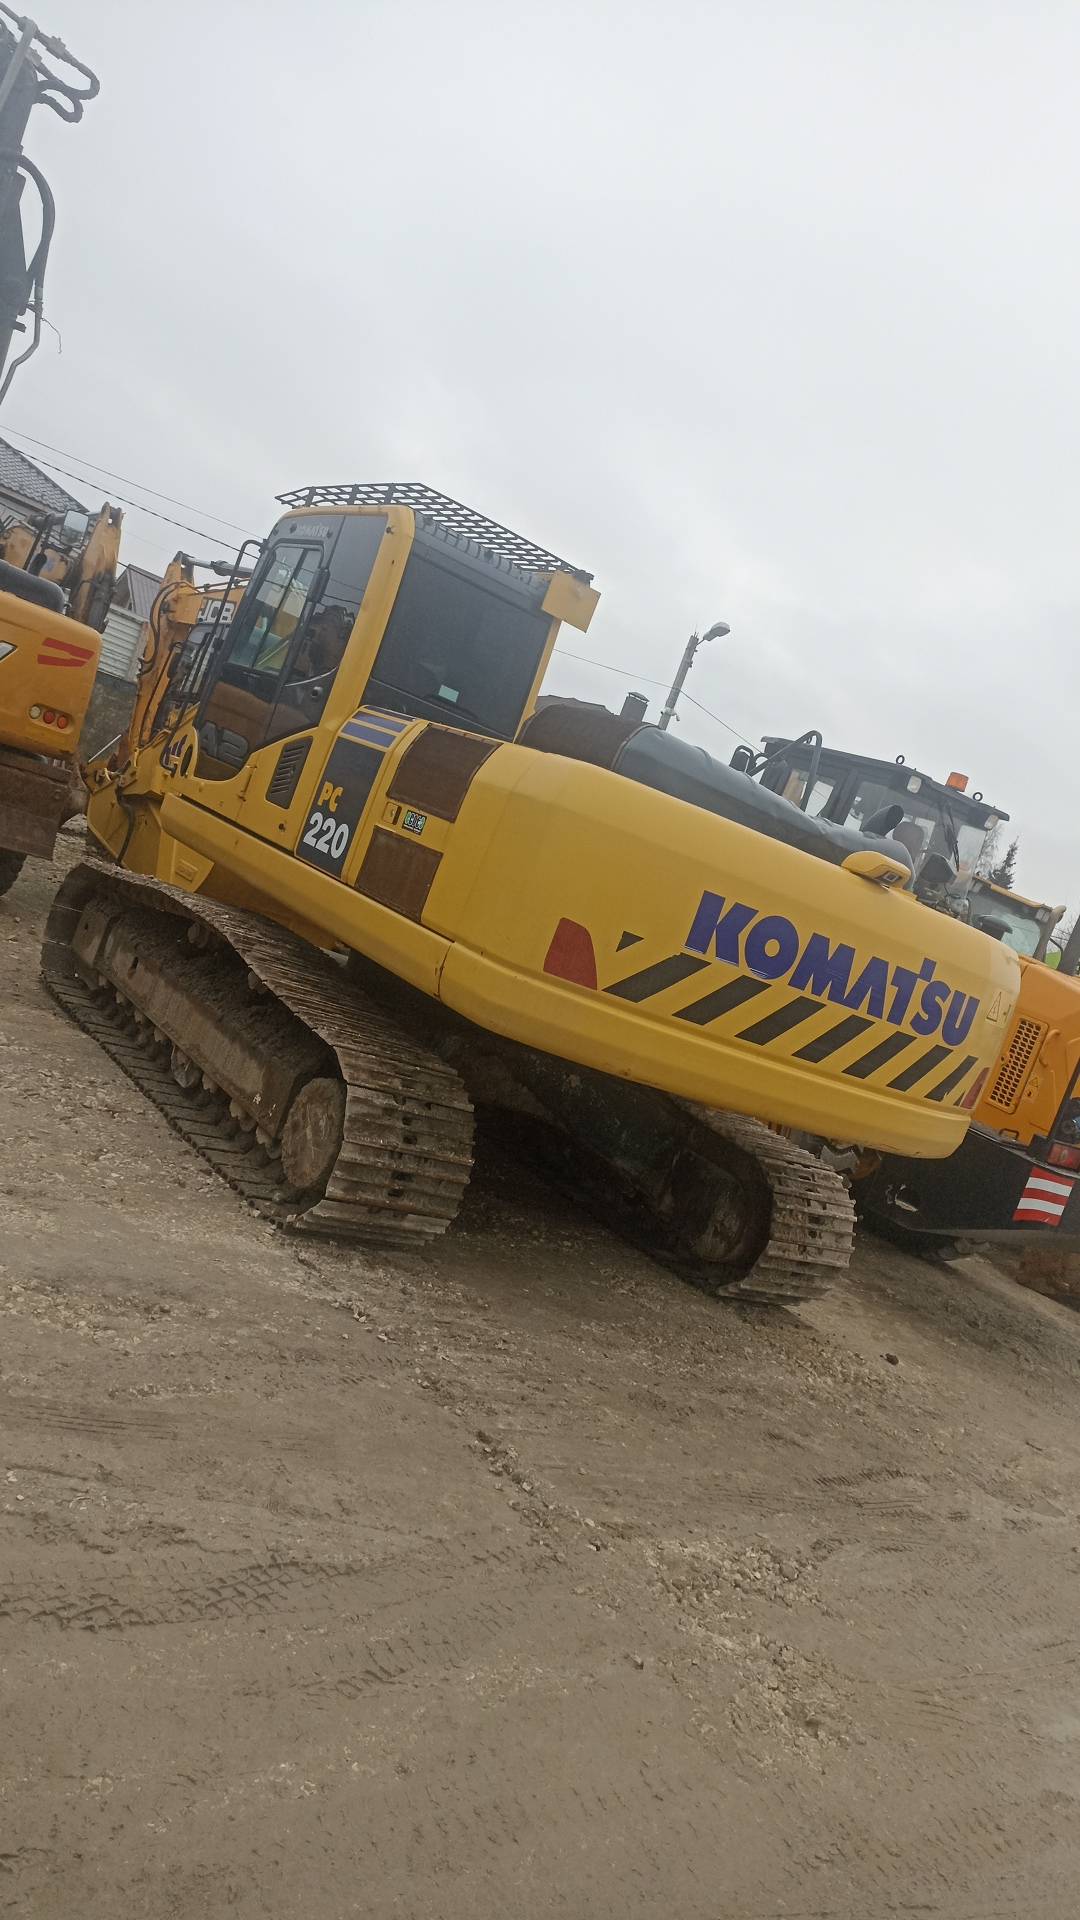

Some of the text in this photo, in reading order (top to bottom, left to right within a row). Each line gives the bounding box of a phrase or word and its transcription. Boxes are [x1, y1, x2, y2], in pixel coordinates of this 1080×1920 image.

[198, 599, 235, 624] JCB
[317, 781, 344, 812] PC
[303, 812, 349, 859] 220
[684, 889, 980, 1047] KOMATSU
